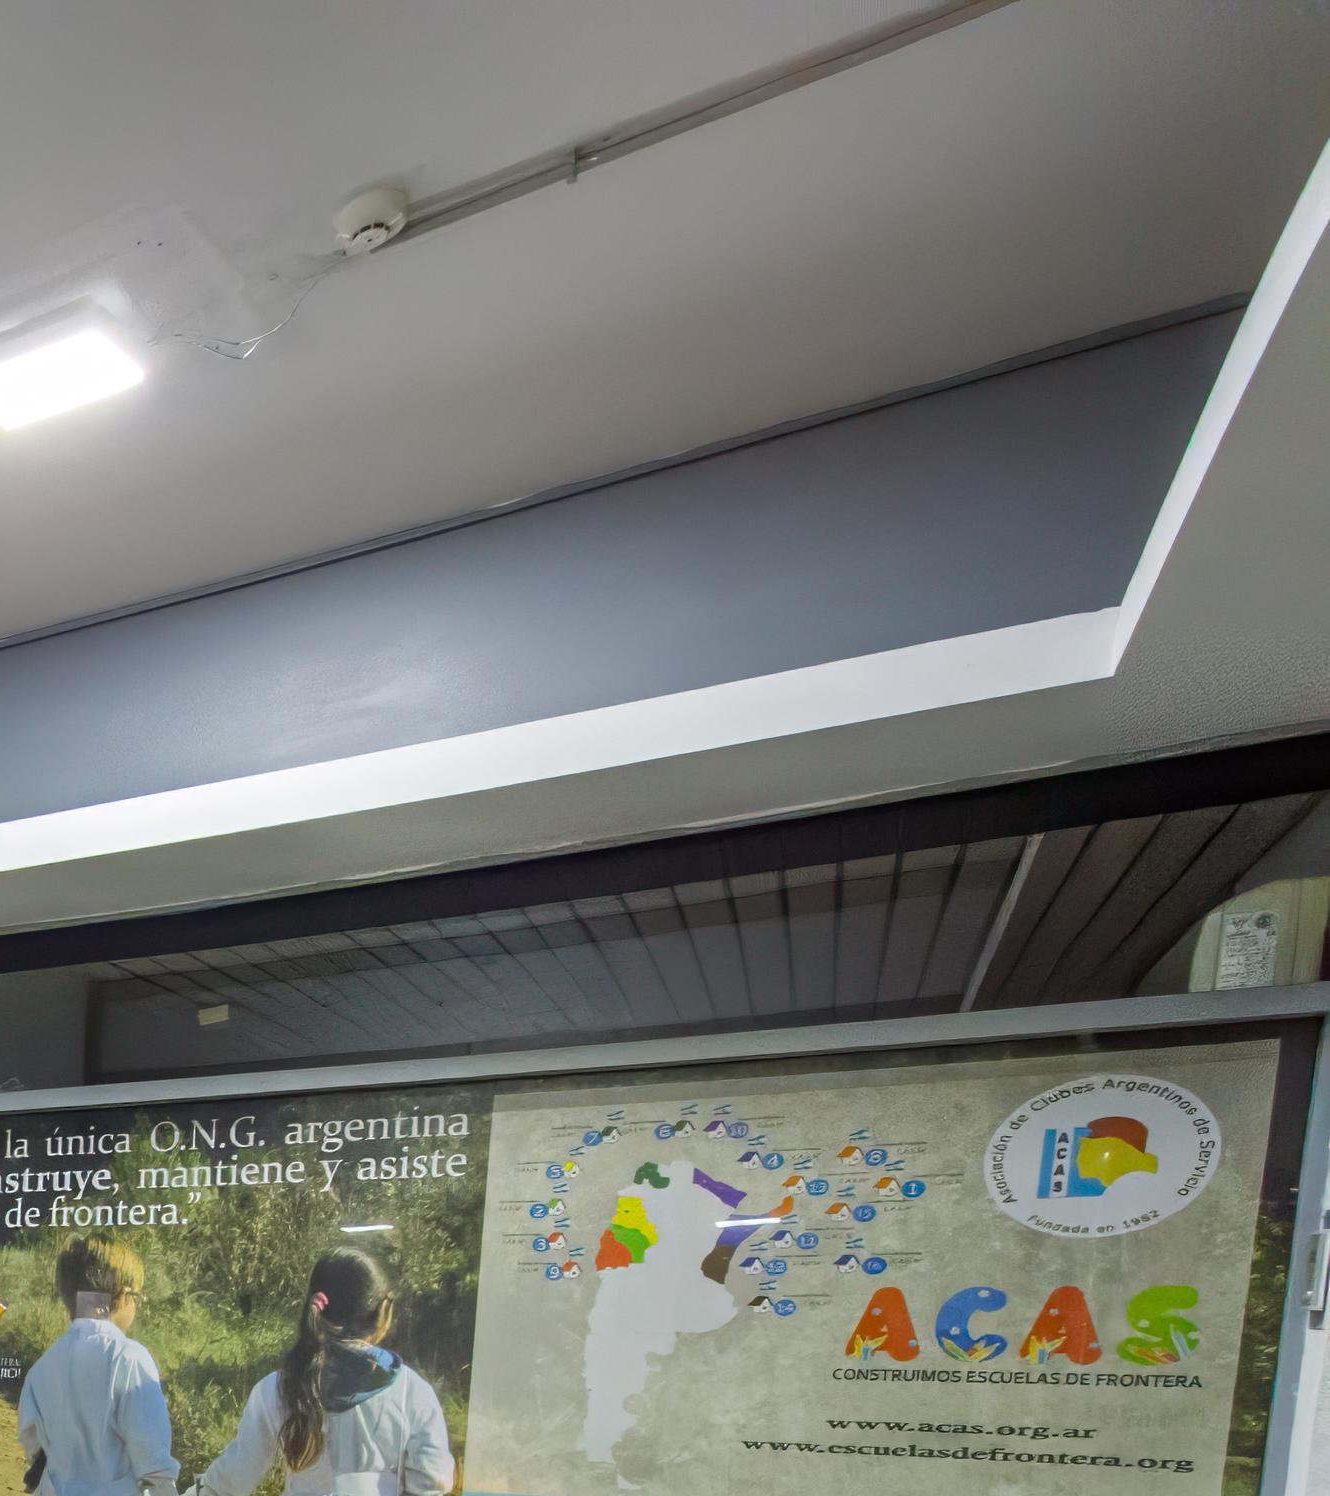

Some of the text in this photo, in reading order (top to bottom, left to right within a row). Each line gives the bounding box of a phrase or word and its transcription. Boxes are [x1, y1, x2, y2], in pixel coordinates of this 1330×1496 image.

[1030, 1081, 1096, 1112] Clubes
[1102, 1078, 1198, 1116] Argentinos
[4, 1129, 29, 1159] la
[45, 1126, 131, 1156] única
[150, 1113, 265, 1152] O.N.G.
[285, 1106, 470, 1152] argentina
[1009, 1114, 1030, 1131] de
[1192, 1117, 1211, 1136] de
[137, 1154, 305, 1189] mantiene
[320, 1159, 343, 1193] y
[357, 1146, 468, 1181] asiste
[1051, 1132, 1070, 1193] ACAS
[1176, 1139, 1216, 1197] Servicio
[5, 1198, 41, 1228] de
[844, 1285, 1201, 1366] ACAS
[832, 1367, 1203, 1389] CONSTRUIMOS ESCUELAS DE FRONTERA
[826, 1418, 1098, 1440] www.acas.org.ar
[741, 1440, 1196, 1474] www.escuelasdefrontera.org
